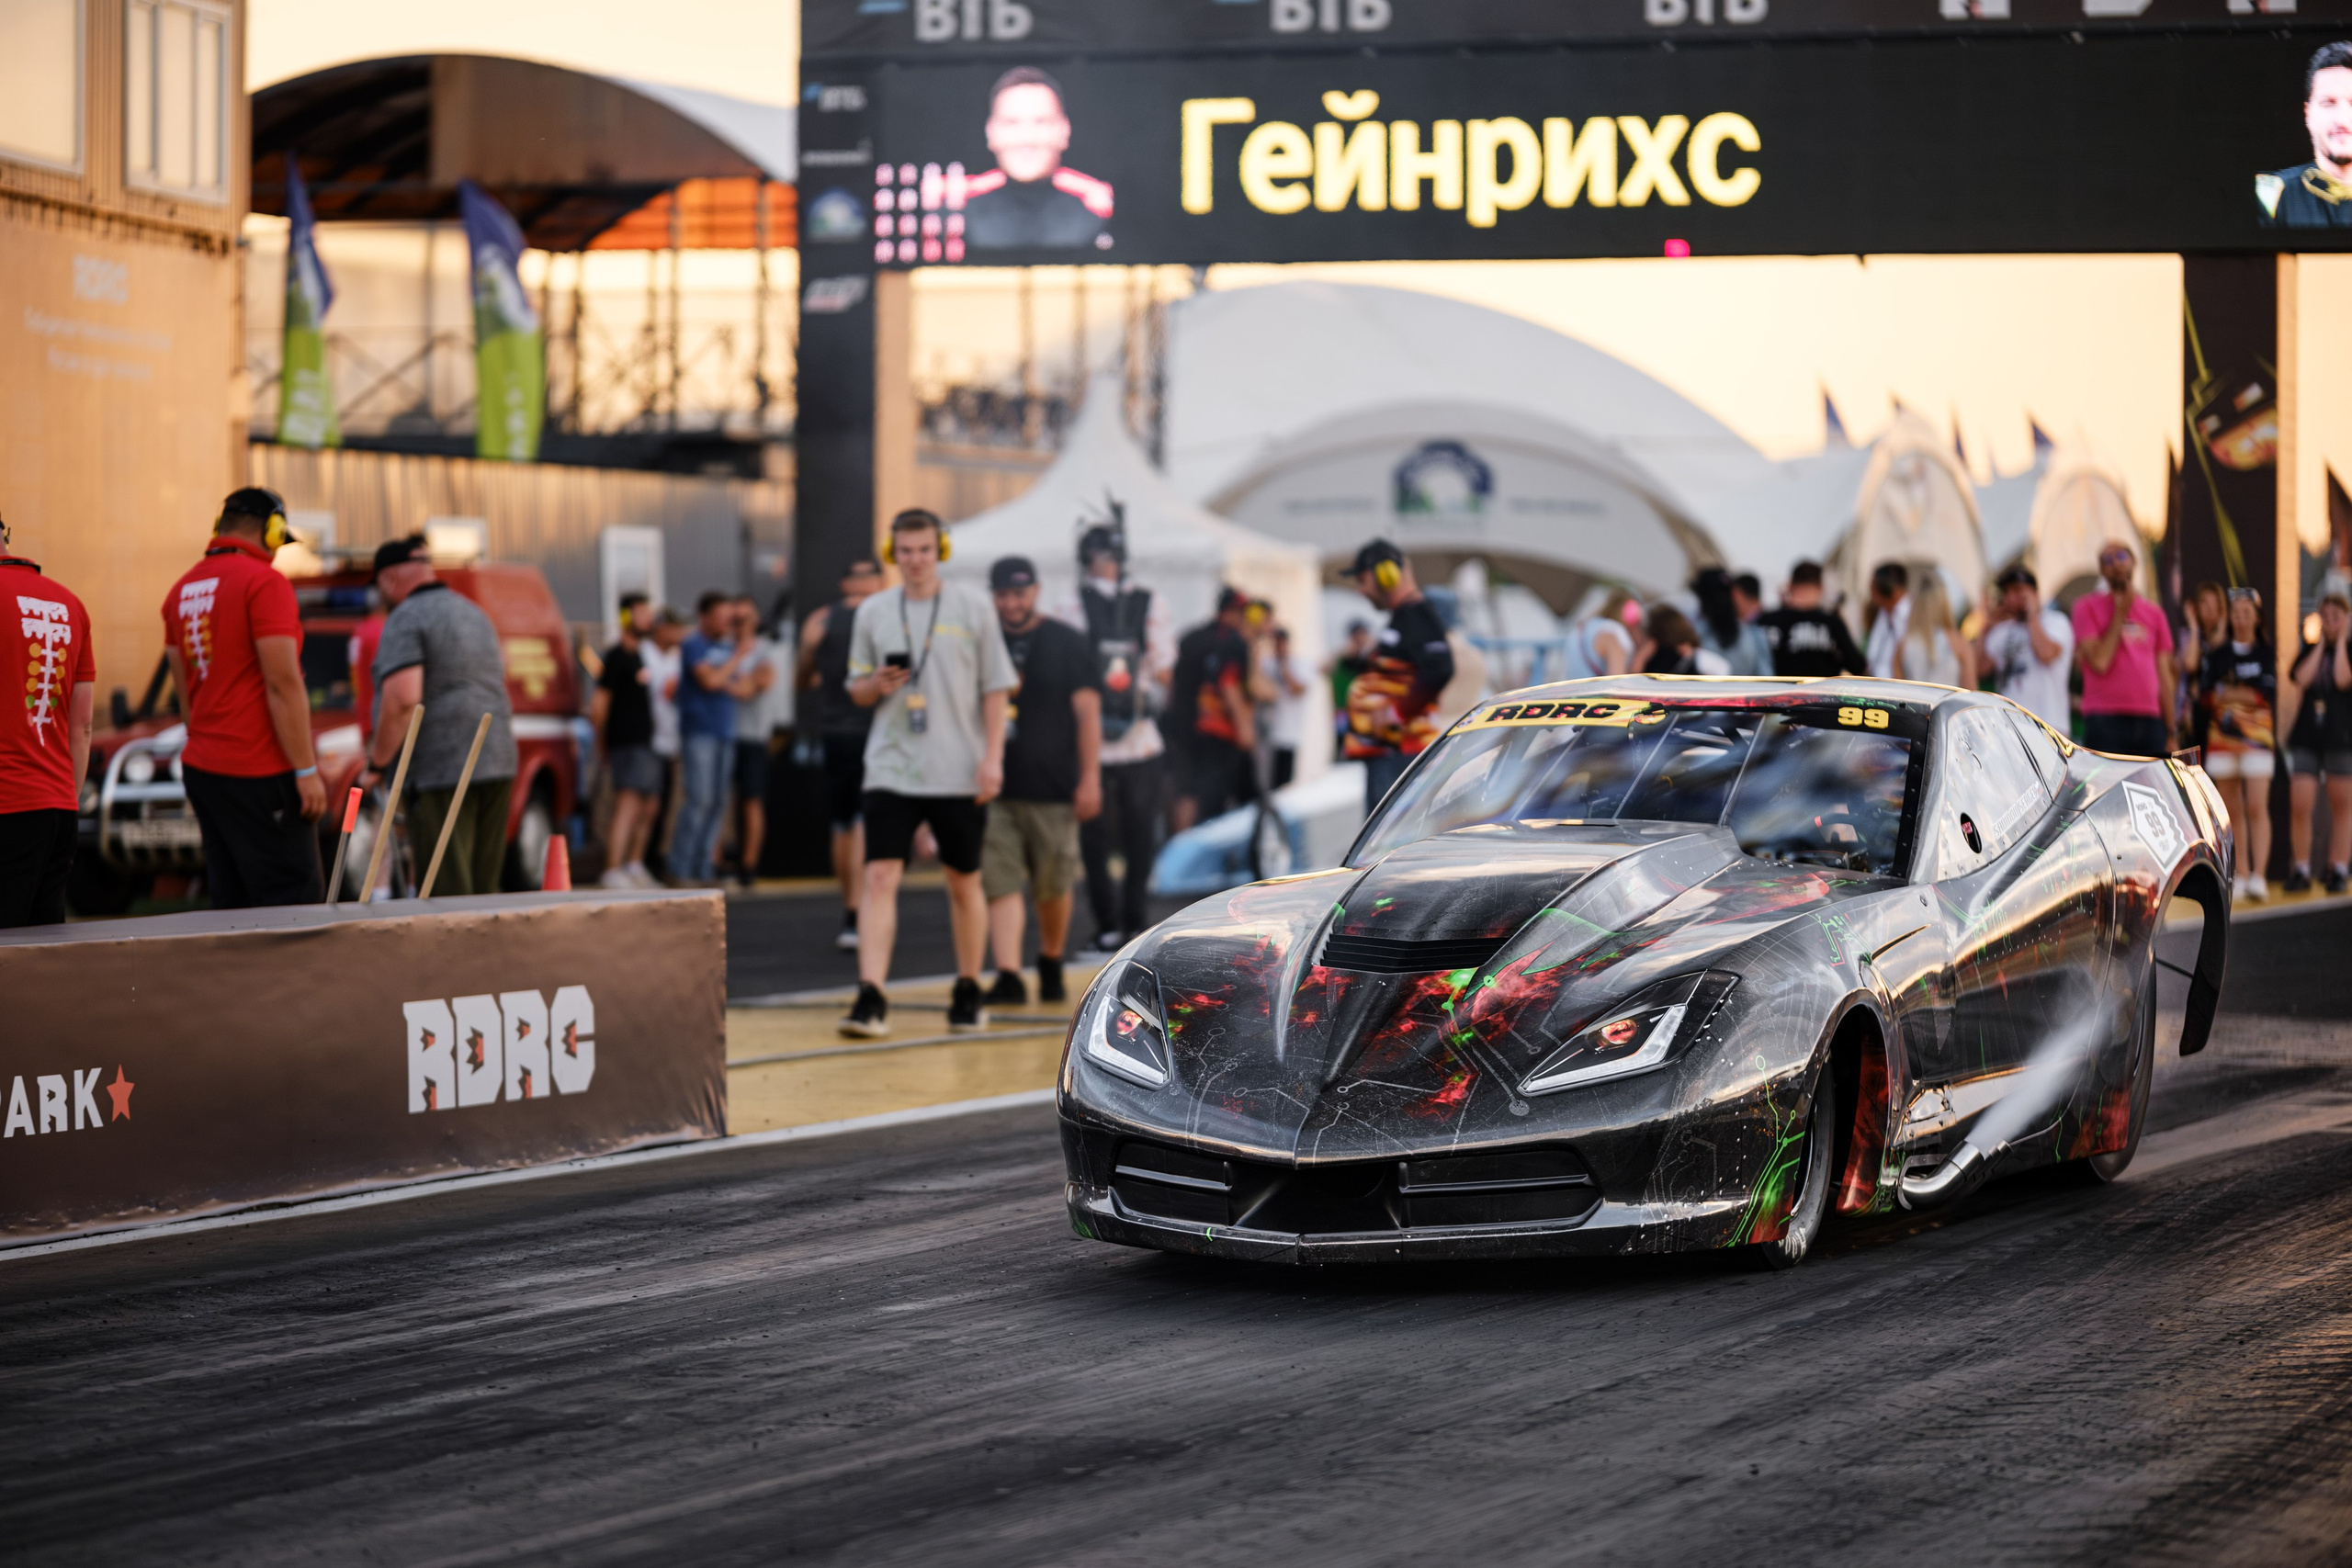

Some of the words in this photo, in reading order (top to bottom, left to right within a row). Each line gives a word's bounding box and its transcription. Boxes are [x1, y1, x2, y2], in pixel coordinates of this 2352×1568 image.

[1181, 89, 1762, 229] Гейнрихс
[1485, 703, 1621, 722] RDRC
[1838, 706, 1889, 729] 99
[2144, 811, 2165, 838] 99
[402, 985, 595, 1114] RDRC
[0, 1067, 104, 1138] ARK
